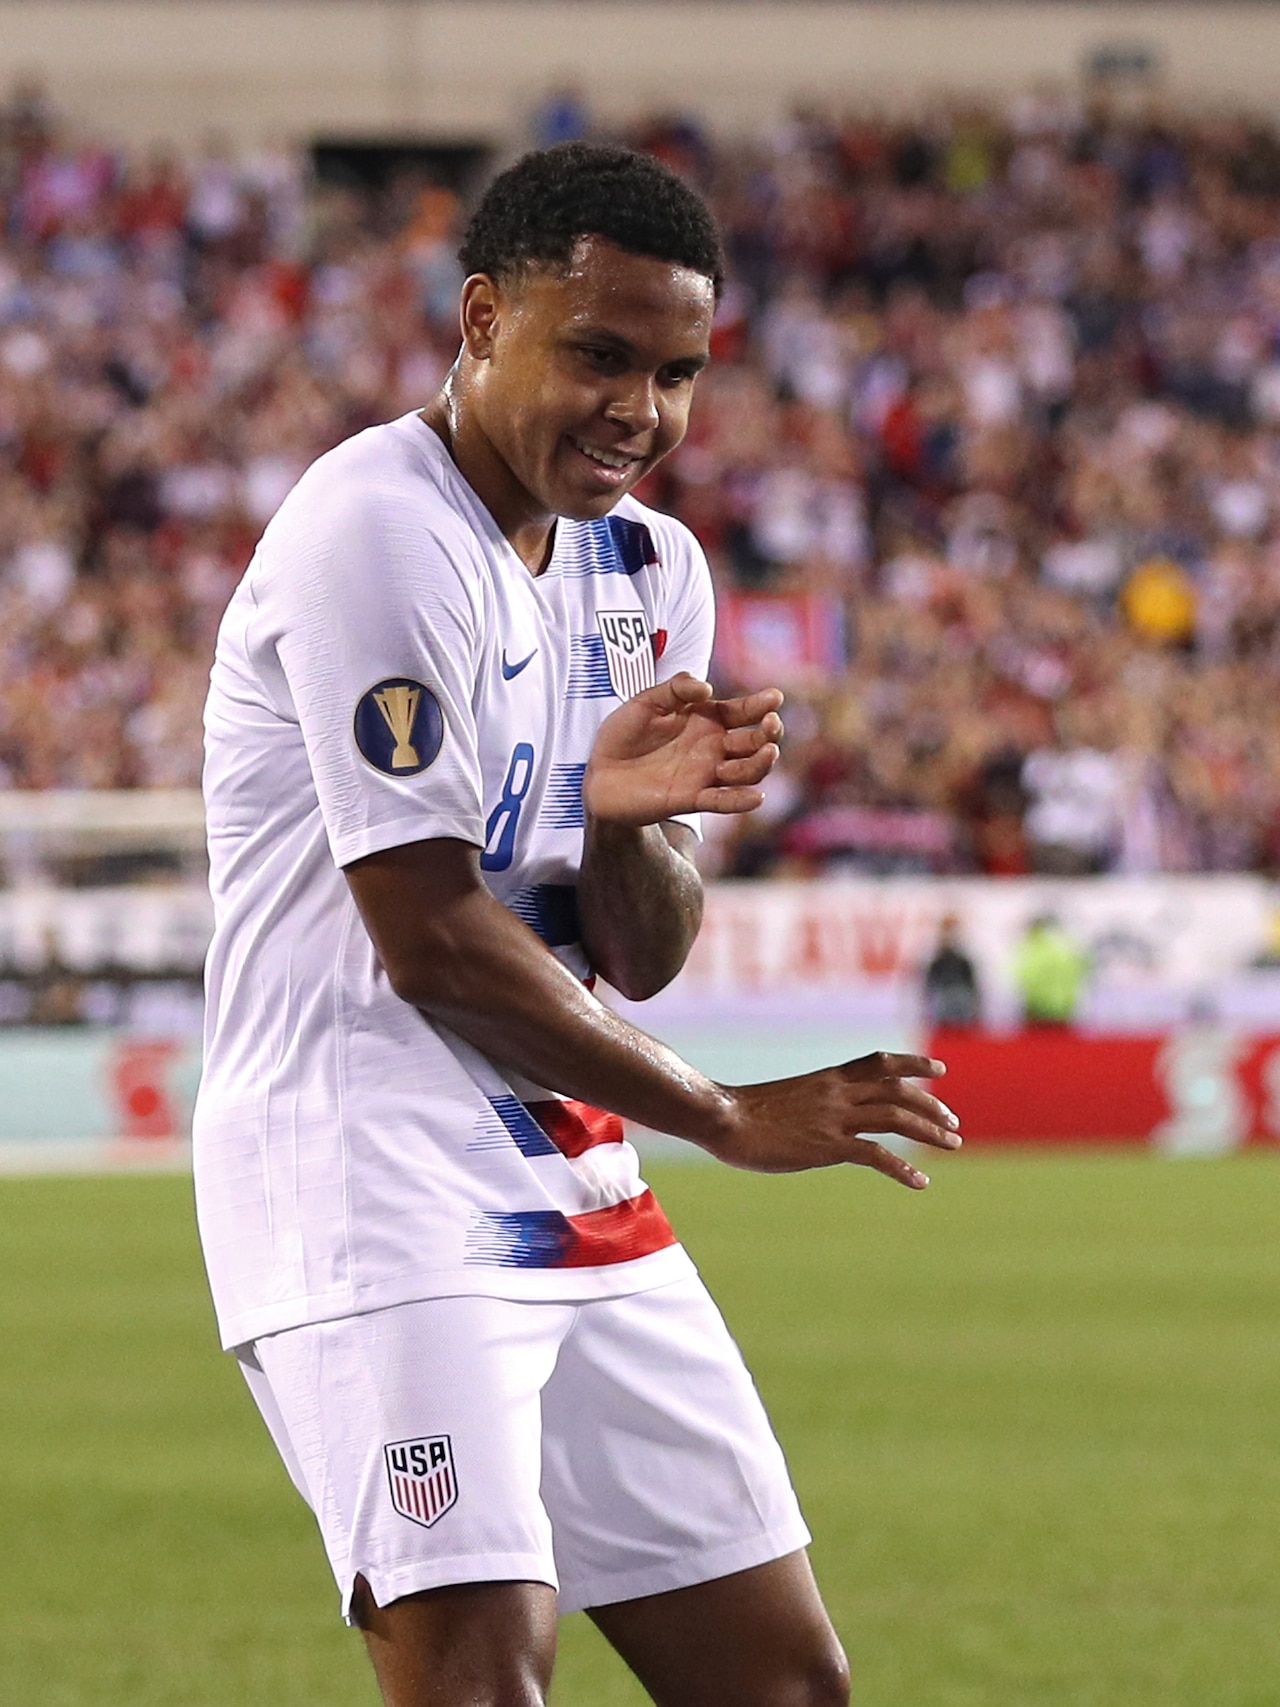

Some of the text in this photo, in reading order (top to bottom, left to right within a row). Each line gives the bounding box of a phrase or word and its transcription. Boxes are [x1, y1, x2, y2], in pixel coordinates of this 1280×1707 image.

[602, 617, 646, 655] USA
[480, 742, 534, 872] 8
[391, 1441, 446, 1477] USA
